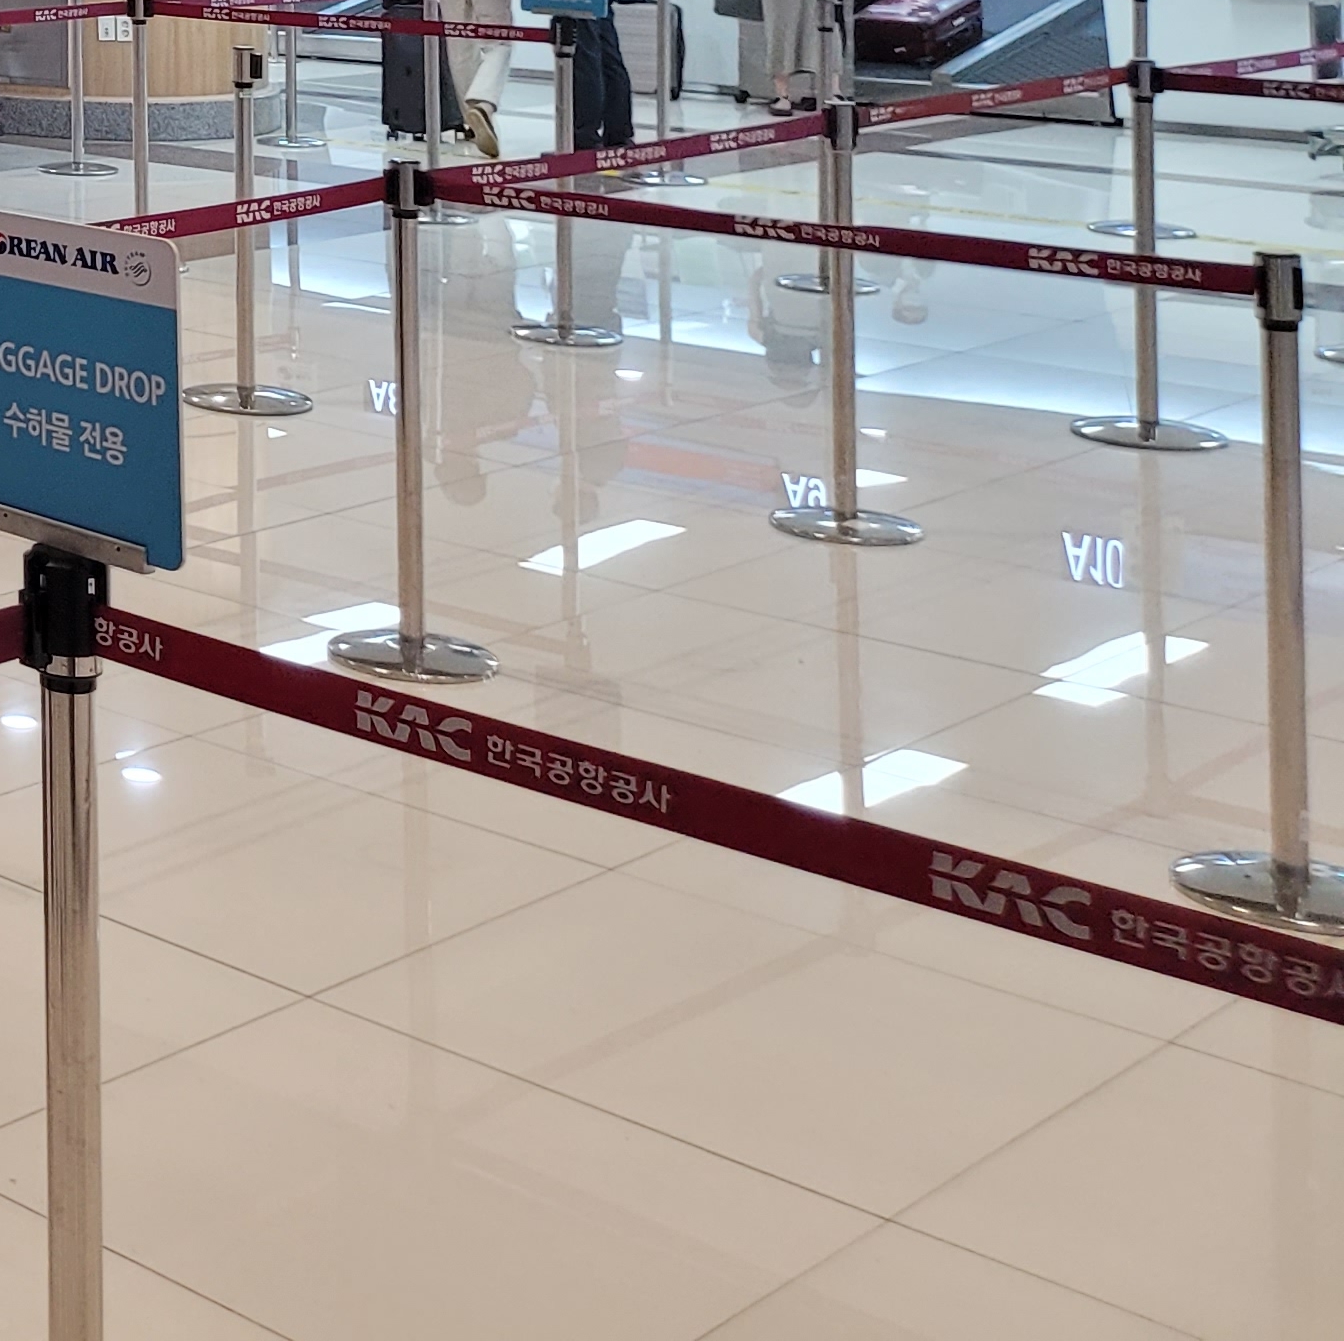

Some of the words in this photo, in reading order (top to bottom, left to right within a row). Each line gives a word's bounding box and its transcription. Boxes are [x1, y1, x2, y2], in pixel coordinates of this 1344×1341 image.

[35, 9, 57, 21] KAC
[204, 8, 230, 20] KAC
[319, 16, 347, 29] KAC
[444, 24, 476, 37] KAC
[473, 164, 502, 184] KAC
[235, 199, 272, 224] KAC
[273, 193, 322, 215] 한국공항공사
[483, 186, 535, 209] KAC
[539, 196, 609, 216] 한국공항공사
[734, 215, 795, 241] KAC
[800, 225, 880, 248] 한국공항공사
[72, 245, 119, 275] AIR
[1028, 248, 1101, 276] KAC
[1106, 258, 1202, 283] 한국공항공사
[94, 360, 166, 406] DROP
[4, 402, 72, 453] 수하물
[79, 420, 127, 465] 전용
[93, 616, 164, 662] 항공사
[354, 689, 473, 762] KAC
[486, 733, 672, 814] 한국공항공사
[928, 850, 1092, 941] KAC
